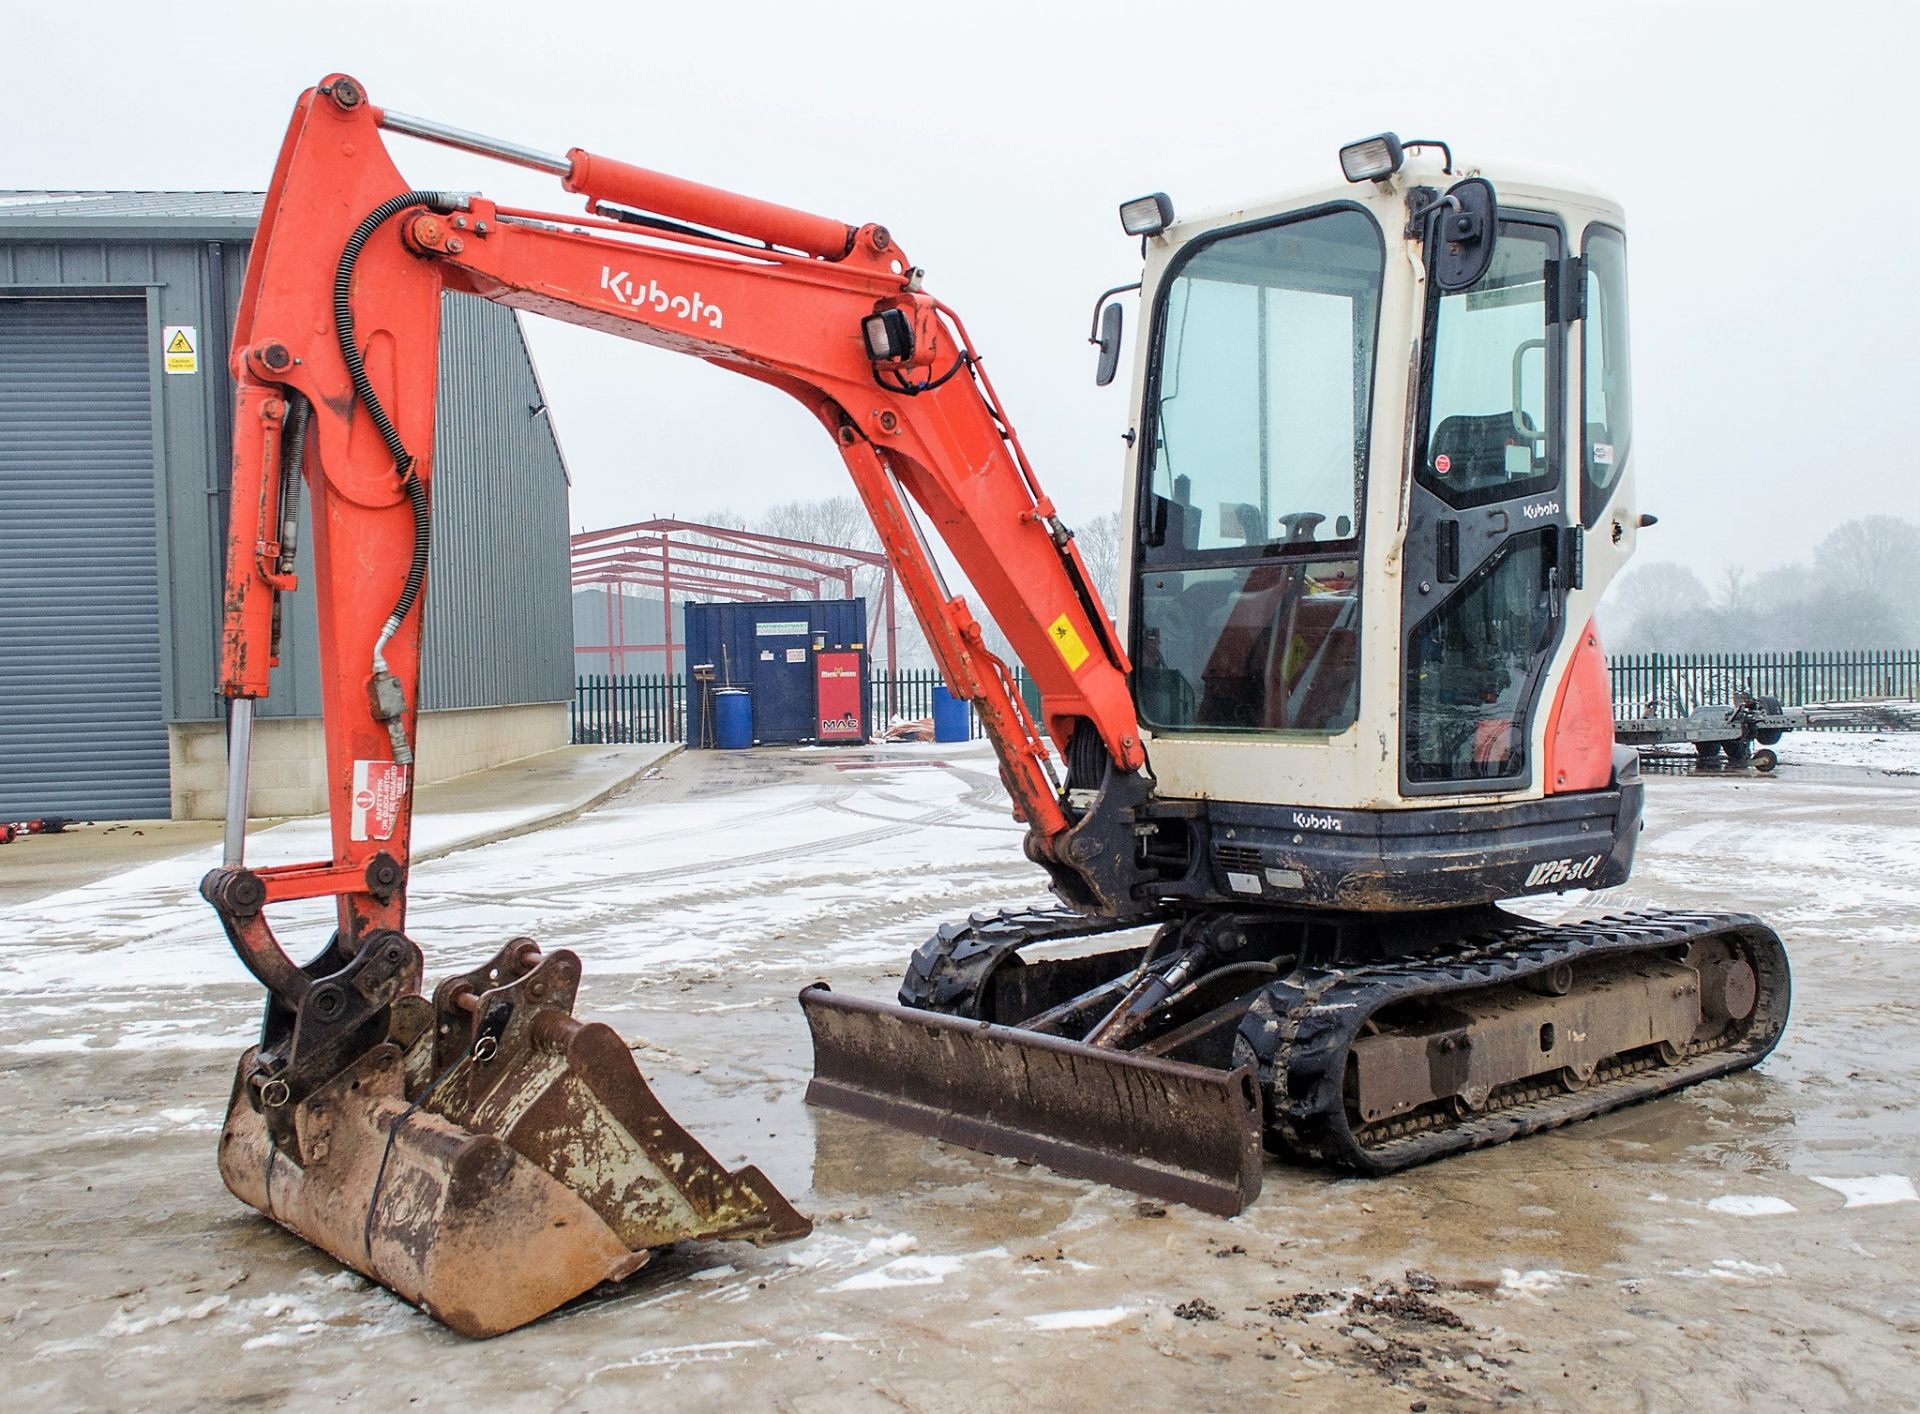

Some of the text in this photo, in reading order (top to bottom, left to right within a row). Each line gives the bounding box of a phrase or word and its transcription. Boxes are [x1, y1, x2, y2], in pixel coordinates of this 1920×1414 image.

[600, 265, 723, 329] Kubota
[1523, 501, 1560, 519] Kubota
[822, 719, 859, 730] MAC
[1293, 812, 1342, 831] Kubota
